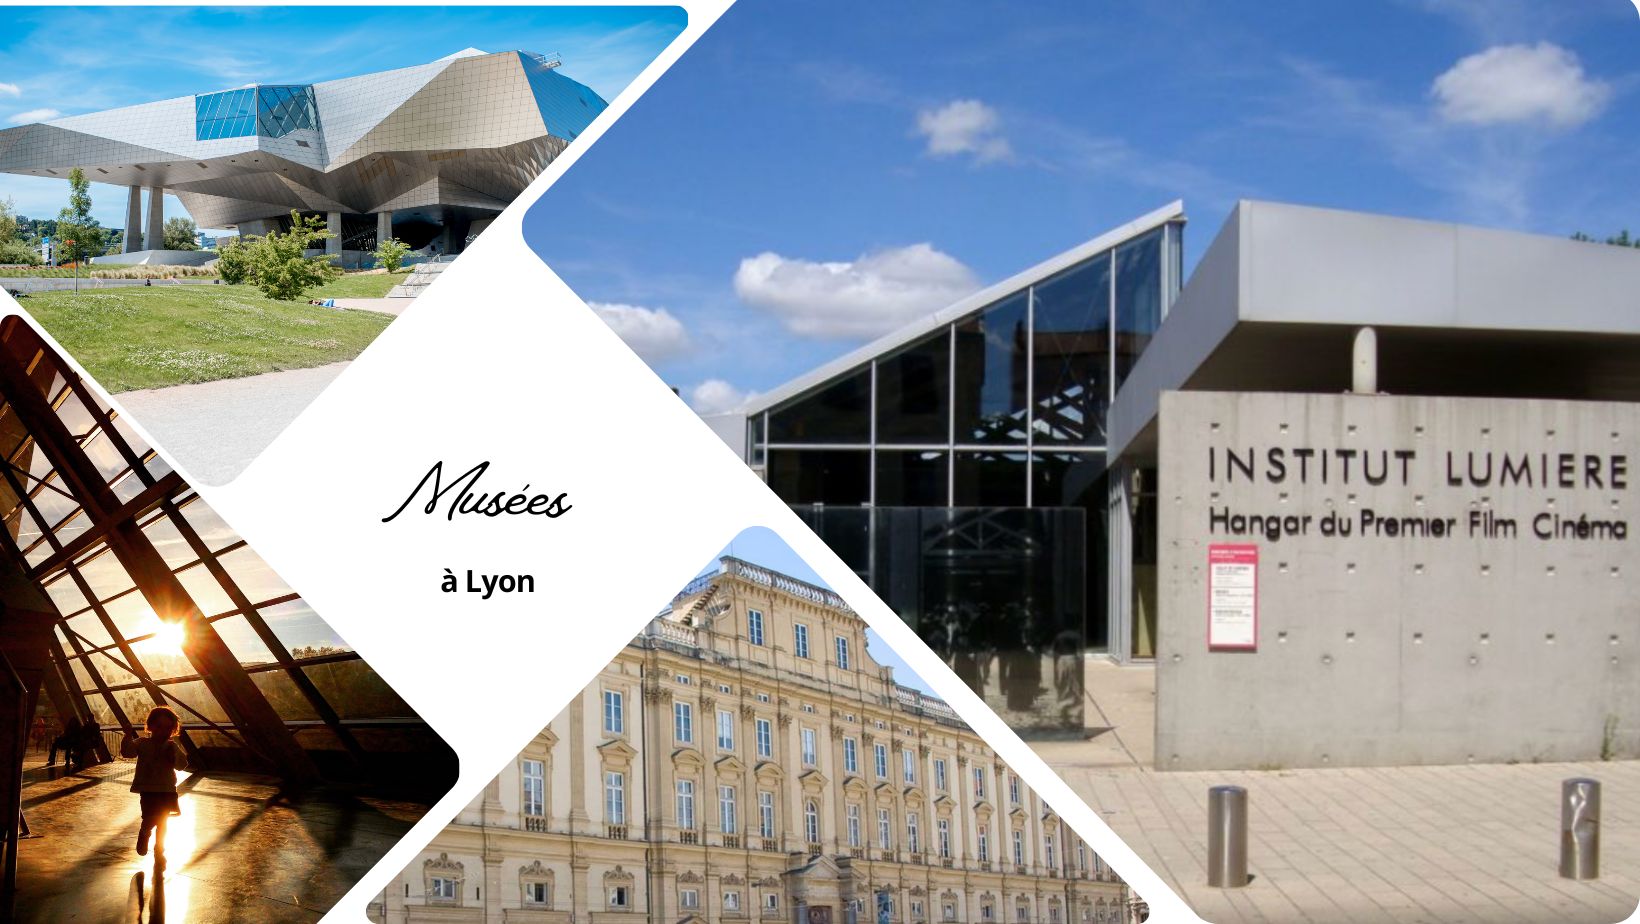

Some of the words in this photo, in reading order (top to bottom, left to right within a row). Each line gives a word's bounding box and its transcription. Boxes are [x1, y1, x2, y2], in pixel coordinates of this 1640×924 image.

[1208, 446, 1416, 486] INSTITUT
[1446, 450, 1628, 489] LUMIERE
[1209, 506, 1311, 542] Hangar
[1320, 510, 1352, 537] du
[1361, 509, 1456, 538] Premier
[1469, 510, 1518, 539] Film
[1533, 511, 1628, 541] Cinéma
